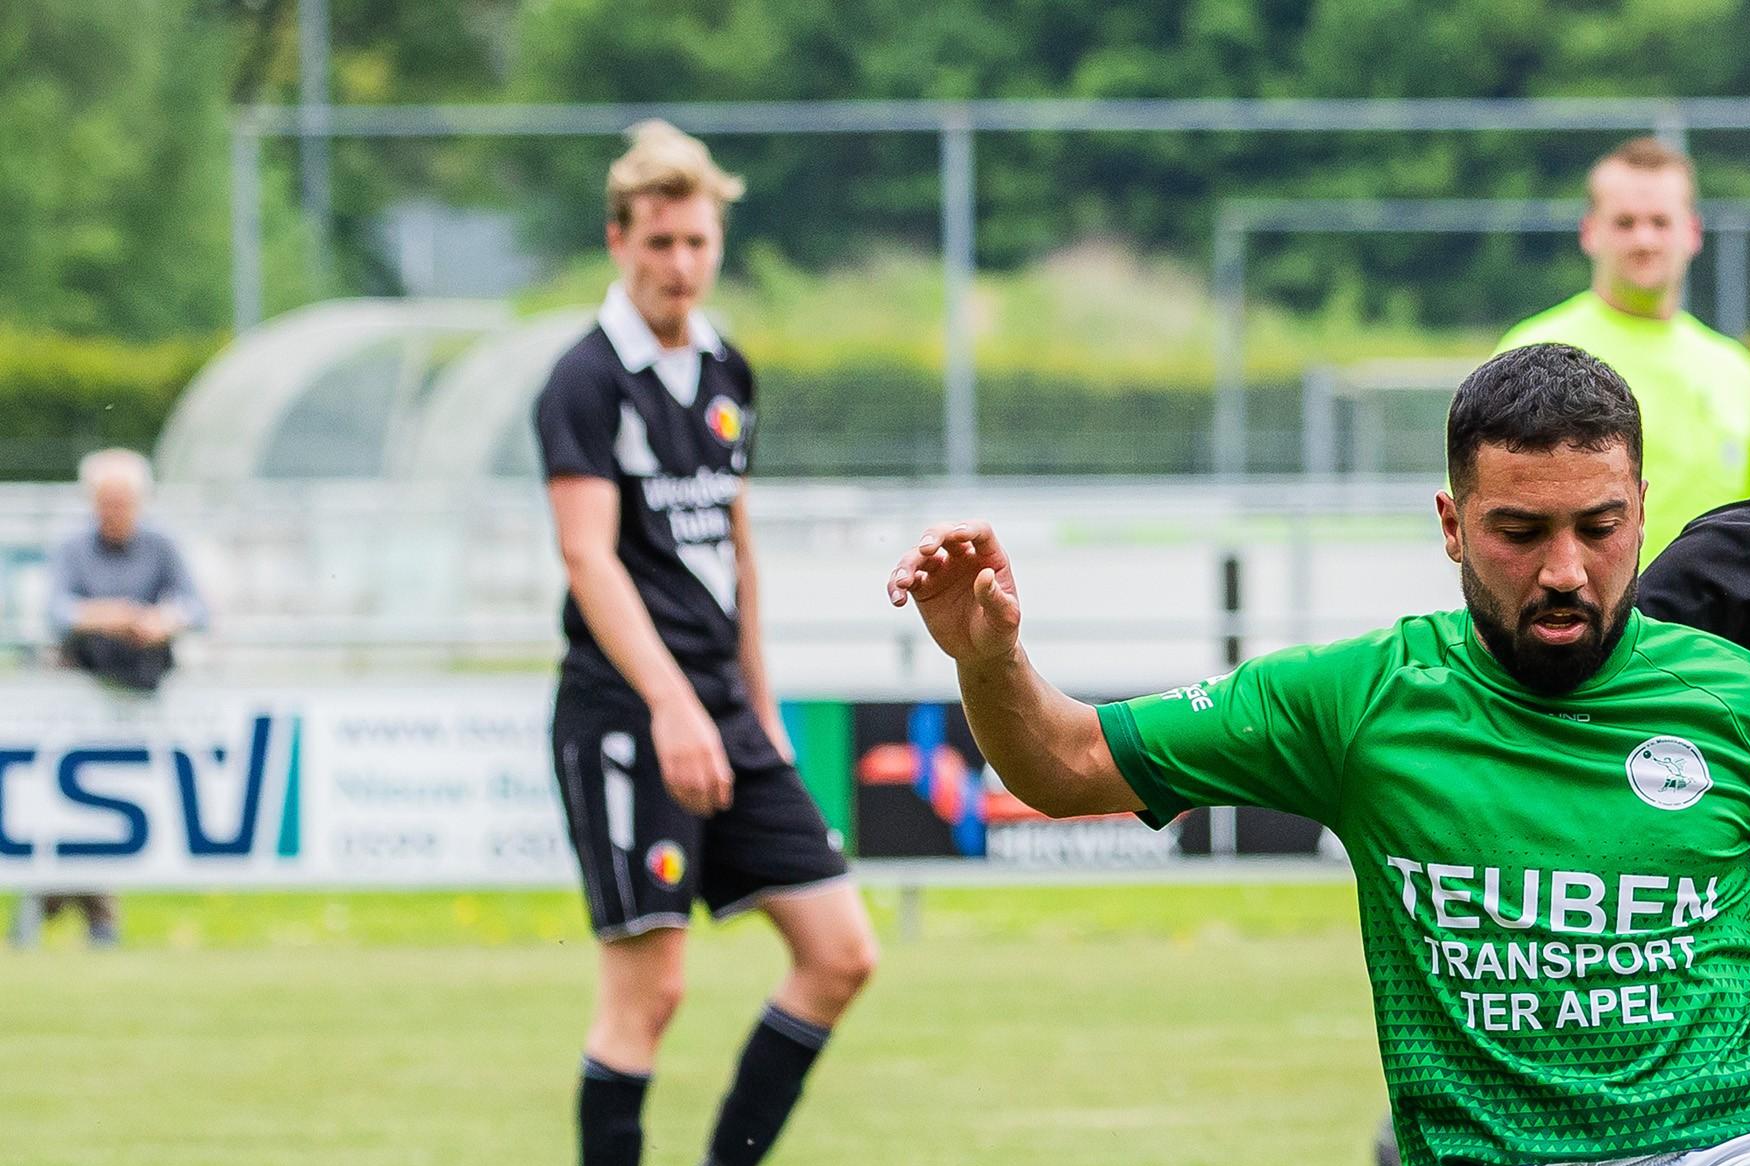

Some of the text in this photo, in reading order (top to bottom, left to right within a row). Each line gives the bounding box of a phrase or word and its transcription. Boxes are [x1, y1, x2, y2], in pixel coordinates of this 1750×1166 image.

[1387, 854, 1719, 935] TEUBEN
[1423, 935, 1696, 980] TRANSPORT
[1460, 984, 1675, 1031] TER APEL
